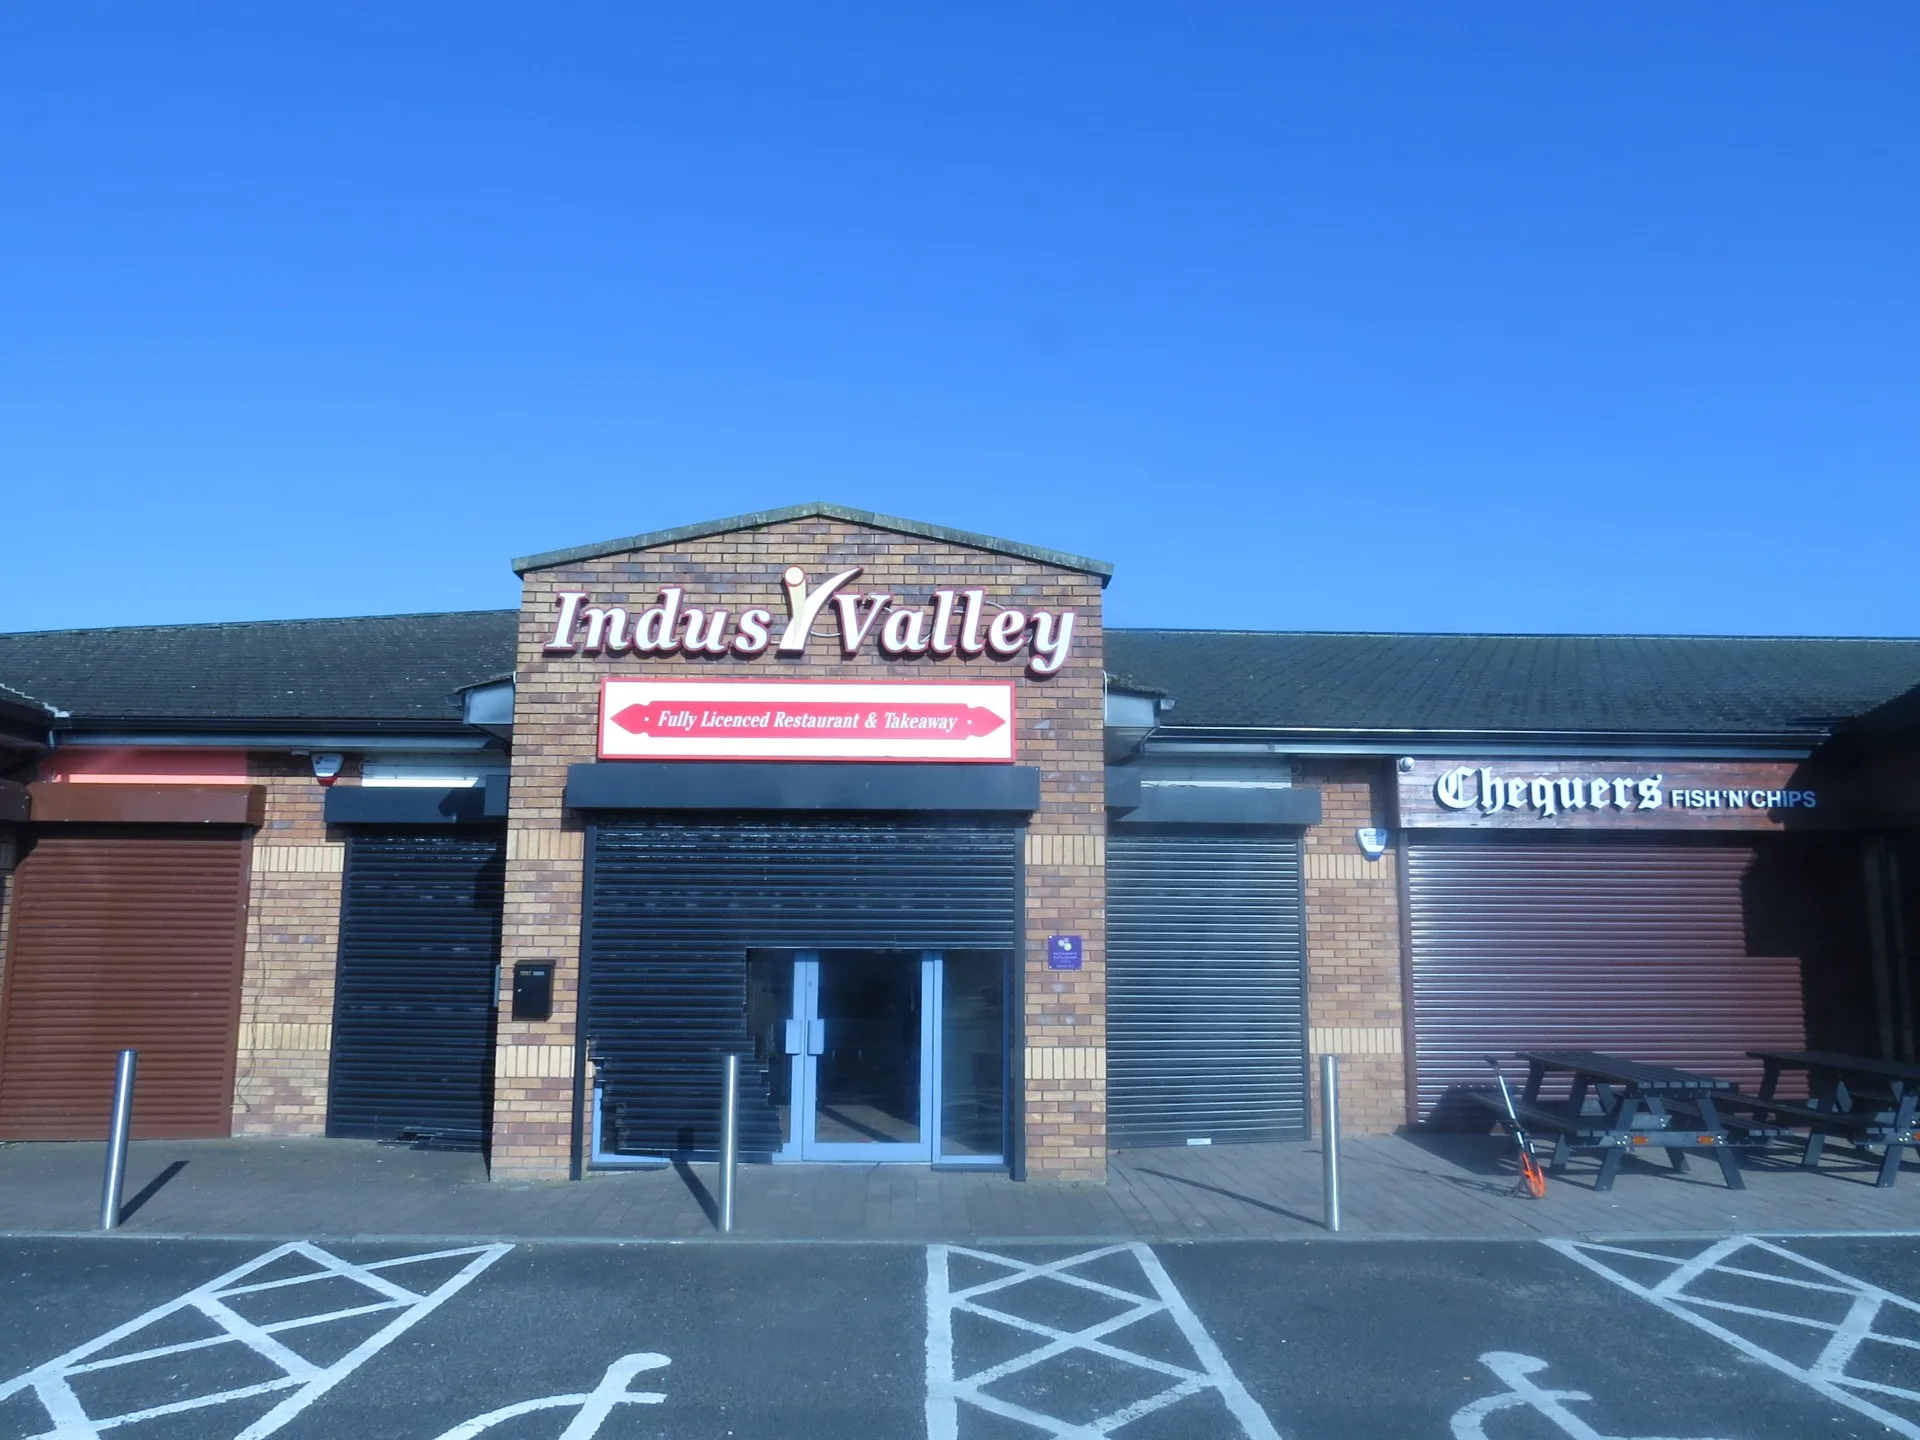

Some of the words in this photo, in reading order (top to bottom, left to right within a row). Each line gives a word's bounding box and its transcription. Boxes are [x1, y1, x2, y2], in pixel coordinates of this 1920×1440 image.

[543, 585, 774, 655] Indus
[833, 586, 1079, 675] Valley
[657, 710, 698, 731] Fully
[700, 711, 771, 728] Licenced
[773, 711, 860, 729] Restaurant
[864, 712, 878, 728] &
[884, 712, 958, 733] Takeaway
[1436, 765, 1663, 817] Chequers
